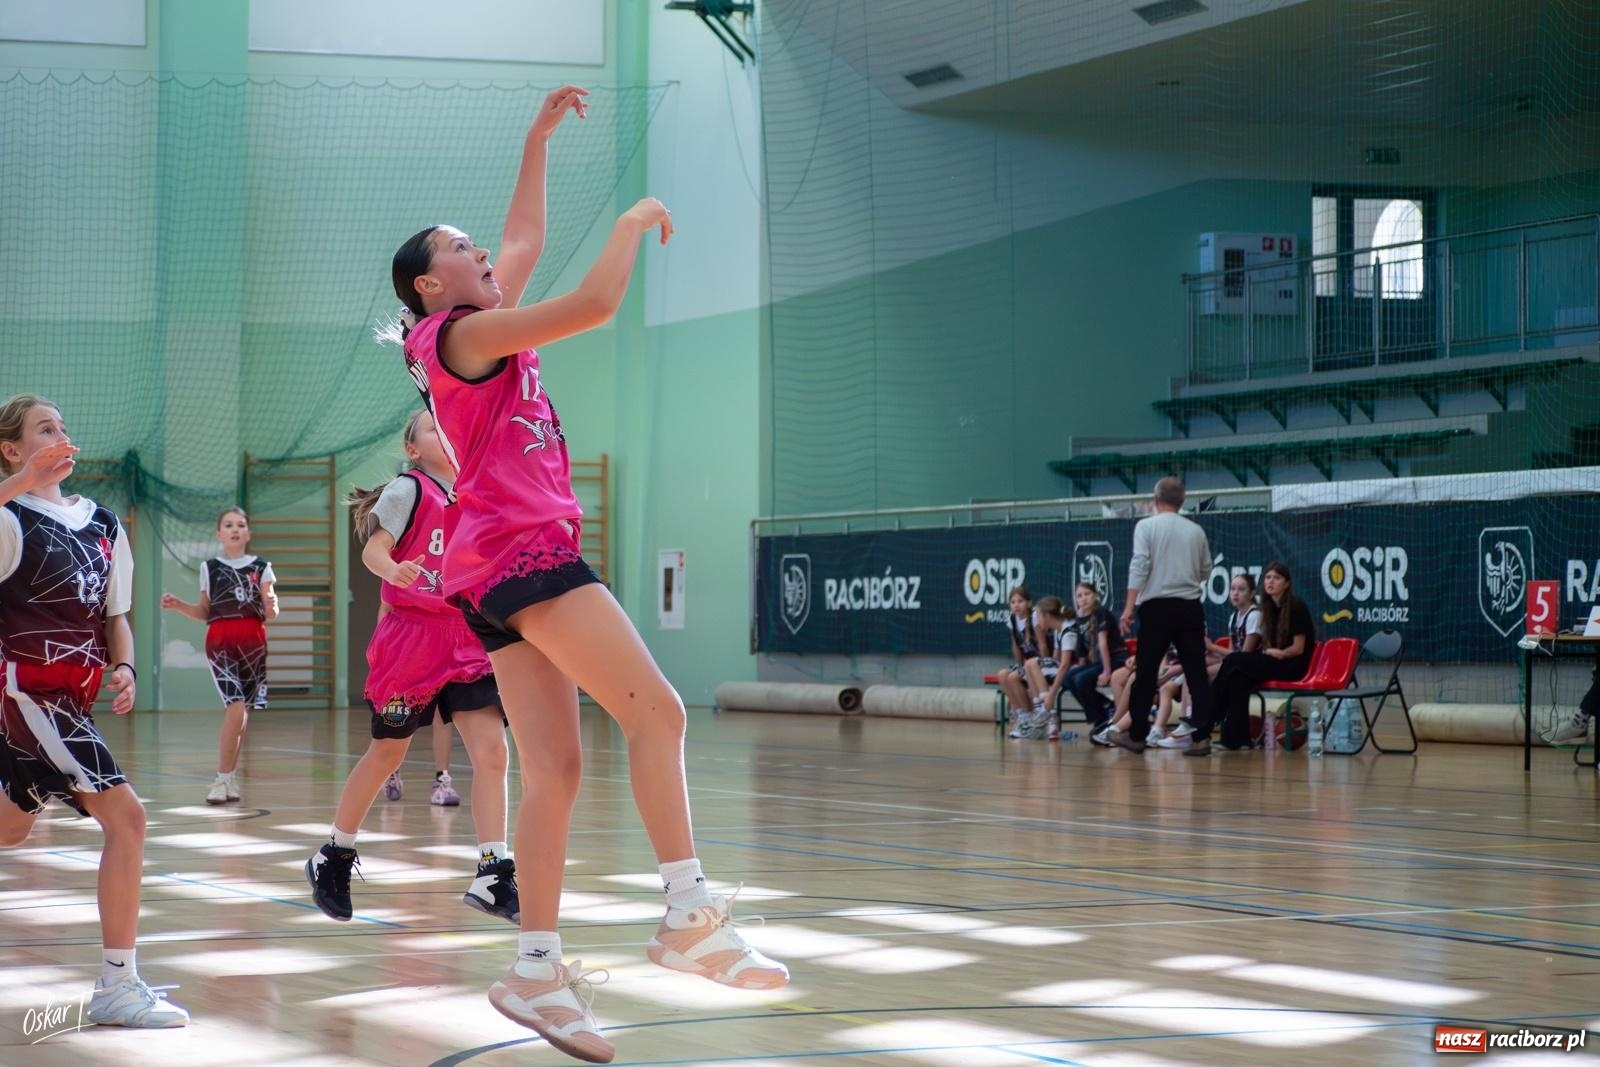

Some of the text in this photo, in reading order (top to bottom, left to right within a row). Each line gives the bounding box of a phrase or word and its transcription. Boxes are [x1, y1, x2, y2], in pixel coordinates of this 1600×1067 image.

[428, 528, 444, 556] 8
[76, 570, 101, 604] 12
[824, 565, 921, 611] RACIBÓRZ
[1357, 603, 1409, 623] RACIBÓRZ
[1531, 586, 1552, 623] 5
